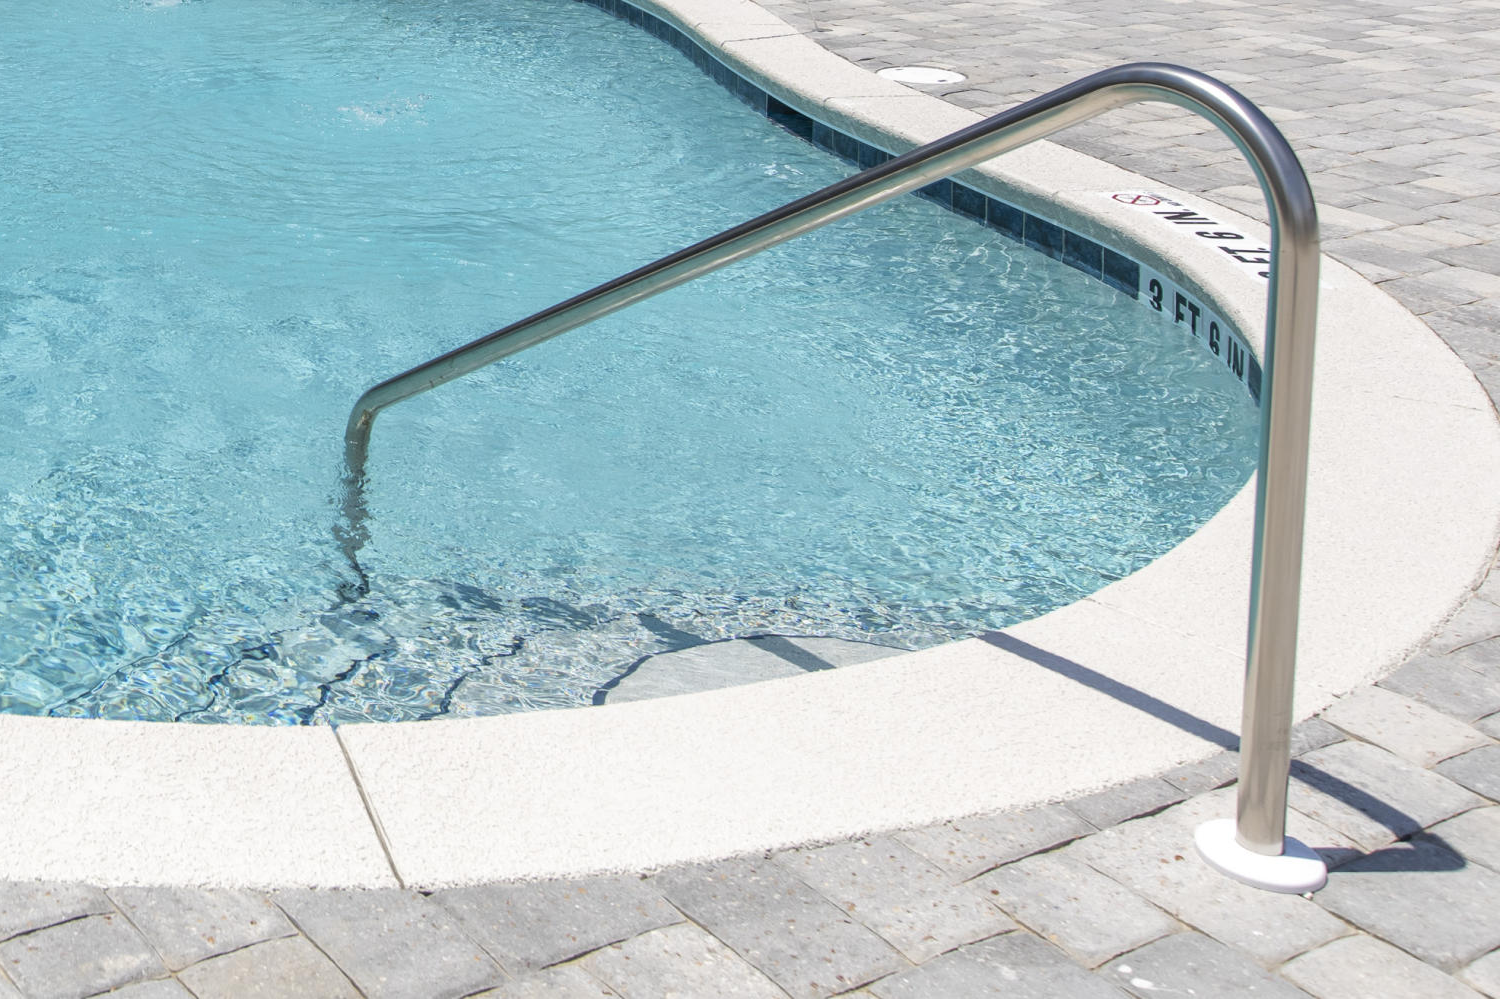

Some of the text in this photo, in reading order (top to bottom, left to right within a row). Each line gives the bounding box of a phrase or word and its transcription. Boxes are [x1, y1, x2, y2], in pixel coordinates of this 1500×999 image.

[1149, 278, 1244, 383] 3 FT 6 IN
